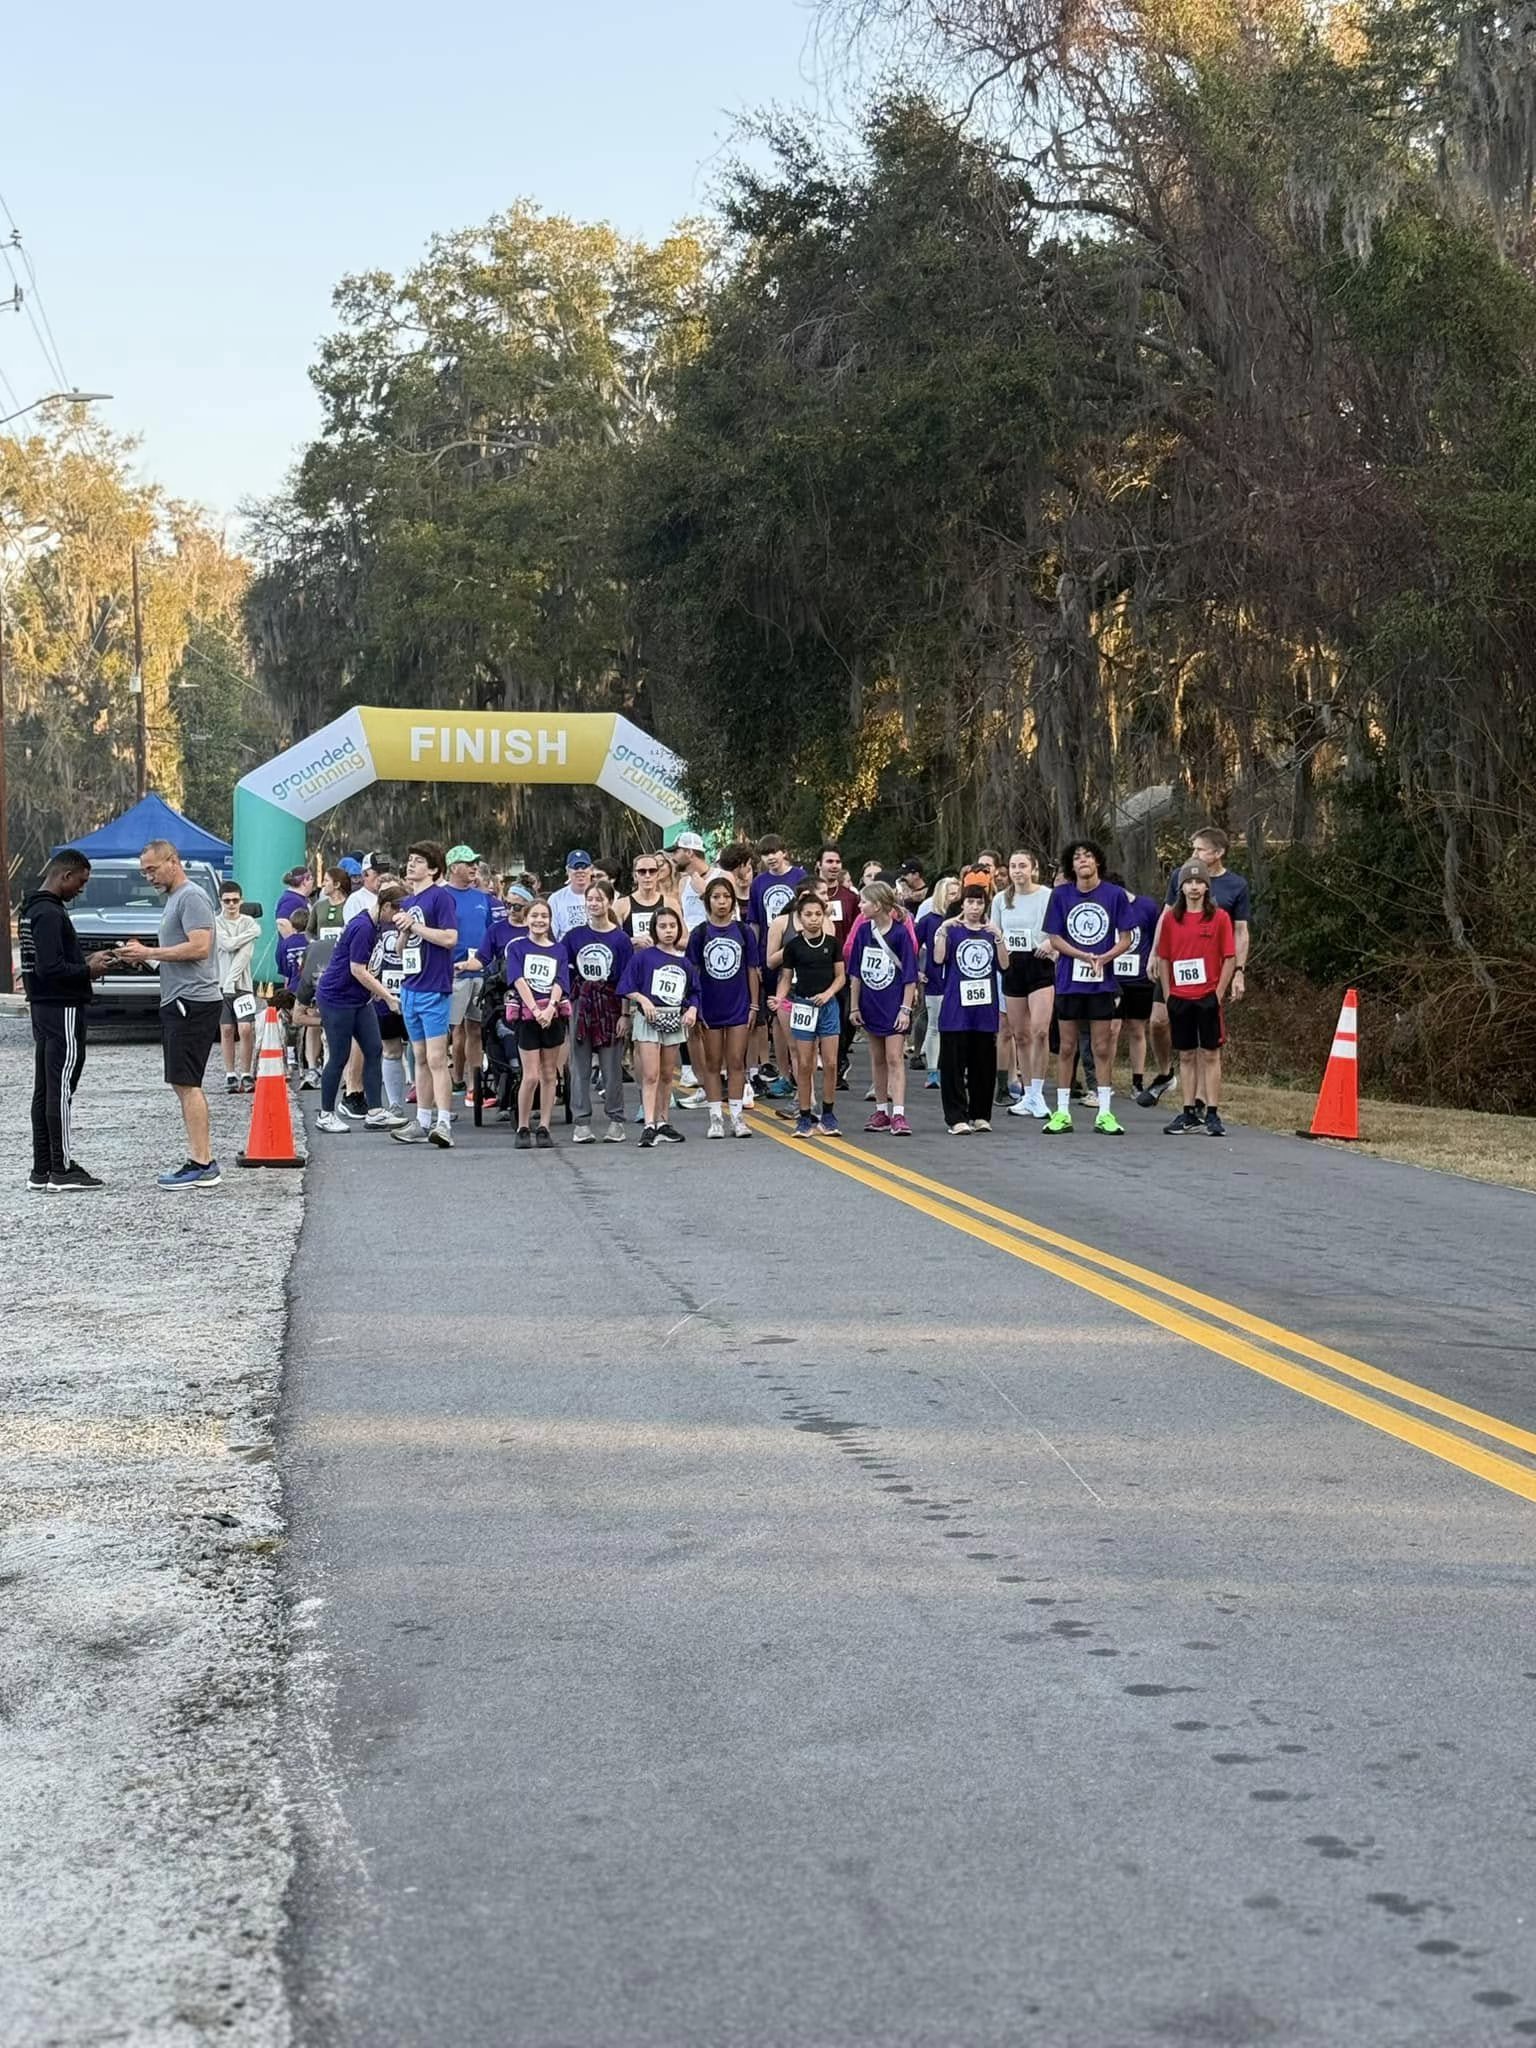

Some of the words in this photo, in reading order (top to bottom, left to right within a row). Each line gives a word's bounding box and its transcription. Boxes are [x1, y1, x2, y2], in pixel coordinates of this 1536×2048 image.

[410, 726, 568, 765] FINISH
[272, 736, 356, 801] grounded
[296, 752, 366, 799] running
[1008, 935, 1027, 948] 963
[866, 955, 882, 969] 772
[1117, 961, 1133, 973] 781
[529, 962, 550, 977] 975
[1178, 967, 1200, 981] 768
[659, 980, 677, 994] 767
[966, 987, 986, 1001] 856
[238, 1000, 254, 1014] 715
